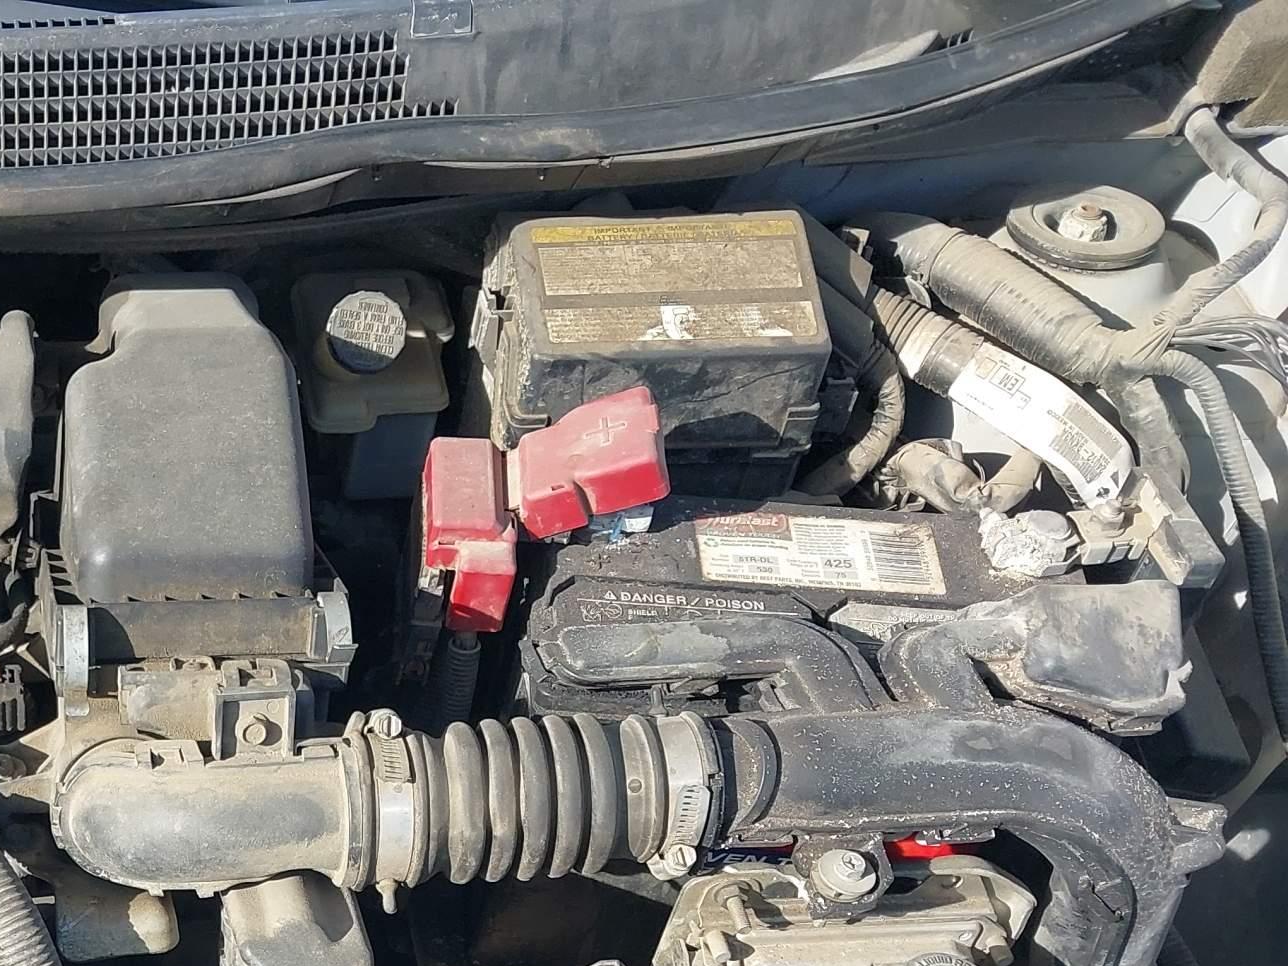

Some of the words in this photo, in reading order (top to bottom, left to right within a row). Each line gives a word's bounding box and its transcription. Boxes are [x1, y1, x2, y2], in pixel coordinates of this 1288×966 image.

[997, 371, 1020, 393] EM
[824, 559, 853, 569] 425
[620, 591, 686, 604] DANGER
[705, 598, 765, 611] POISON
